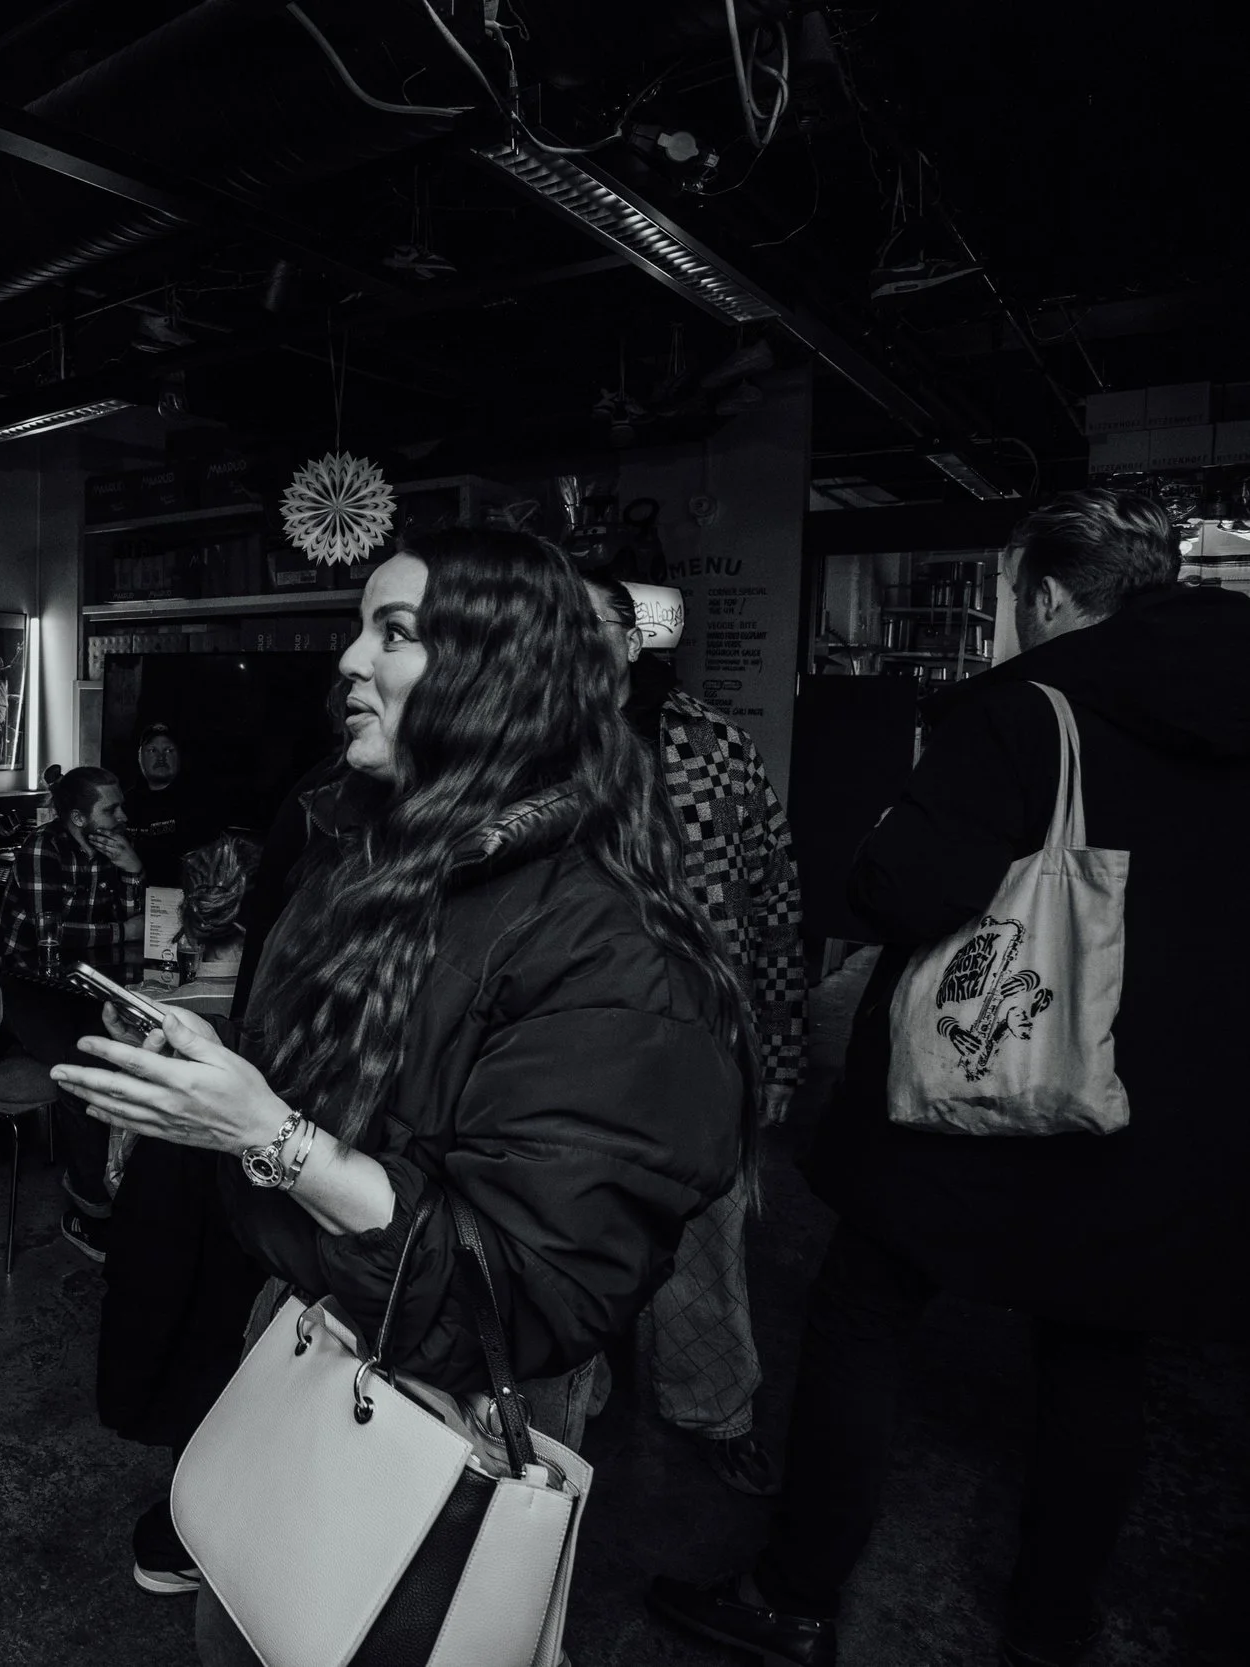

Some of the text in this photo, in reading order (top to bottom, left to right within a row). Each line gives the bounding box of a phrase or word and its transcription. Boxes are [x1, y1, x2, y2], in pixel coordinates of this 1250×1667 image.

[1152, 455, 1208, 466] RITZENHOFF
[668, 556, 743, 580] MENU
[1030, 988, 1054, 1018] 25
